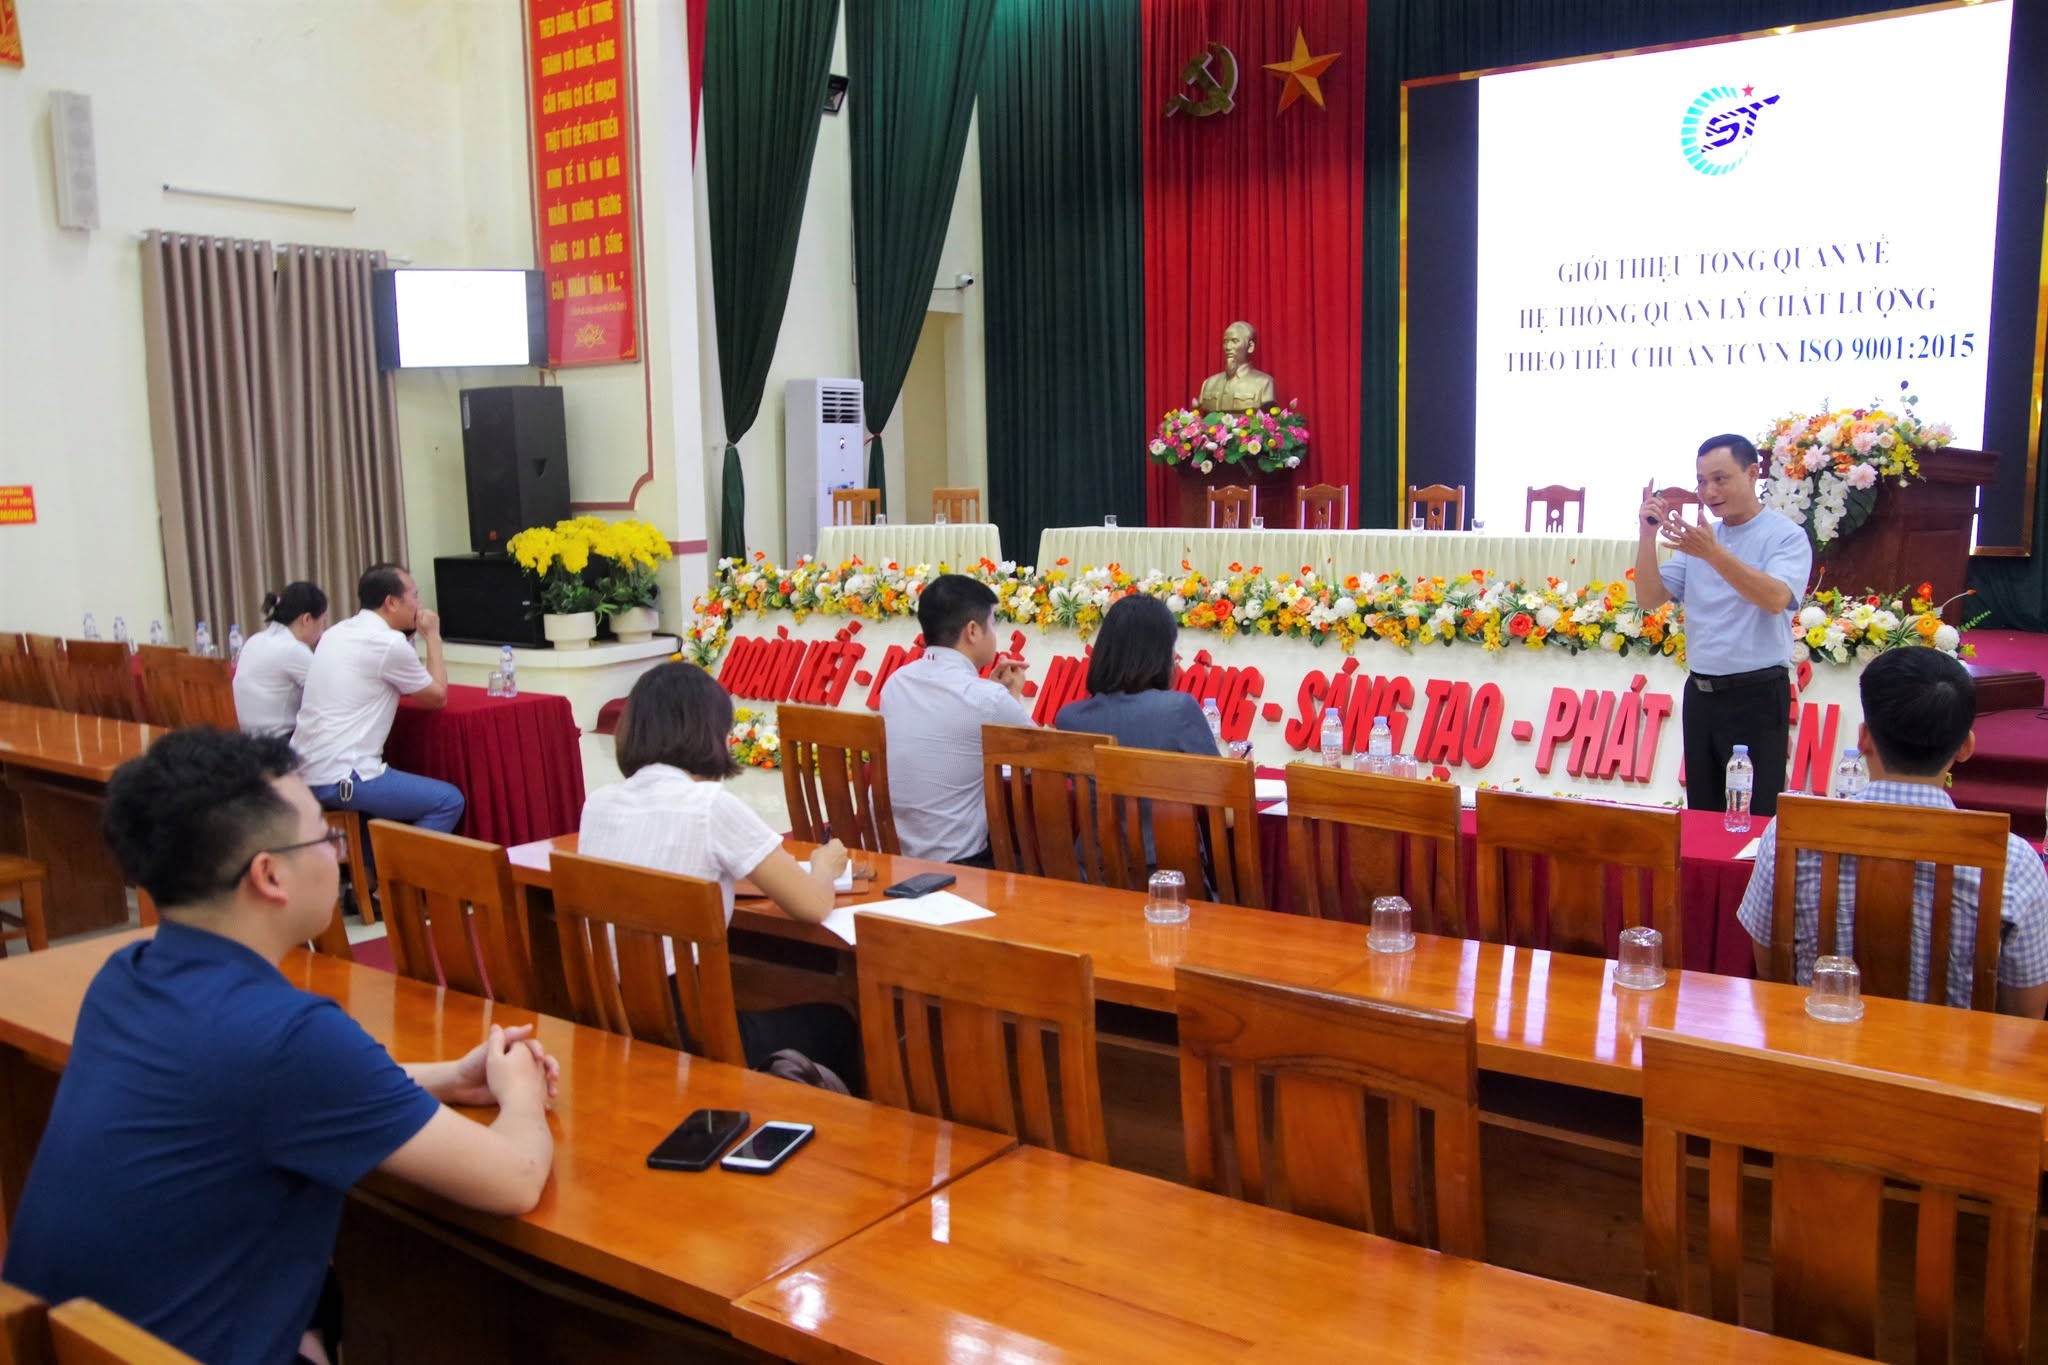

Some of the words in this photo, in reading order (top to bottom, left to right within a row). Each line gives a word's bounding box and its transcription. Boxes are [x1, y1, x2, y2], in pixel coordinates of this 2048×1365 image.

[1504, 351, 1565, 372] THEO
[1800, 338, 1844, 363] ISO
[1852, 332, 1975, 361] 9001:2015
[789, 620, 867, 707] KẾT
[1285, 656, 1415, 756] SÁNG
[1414, 679, 1504, 782] TẠO
[1535, 674, 1674, 784] PHÁT
